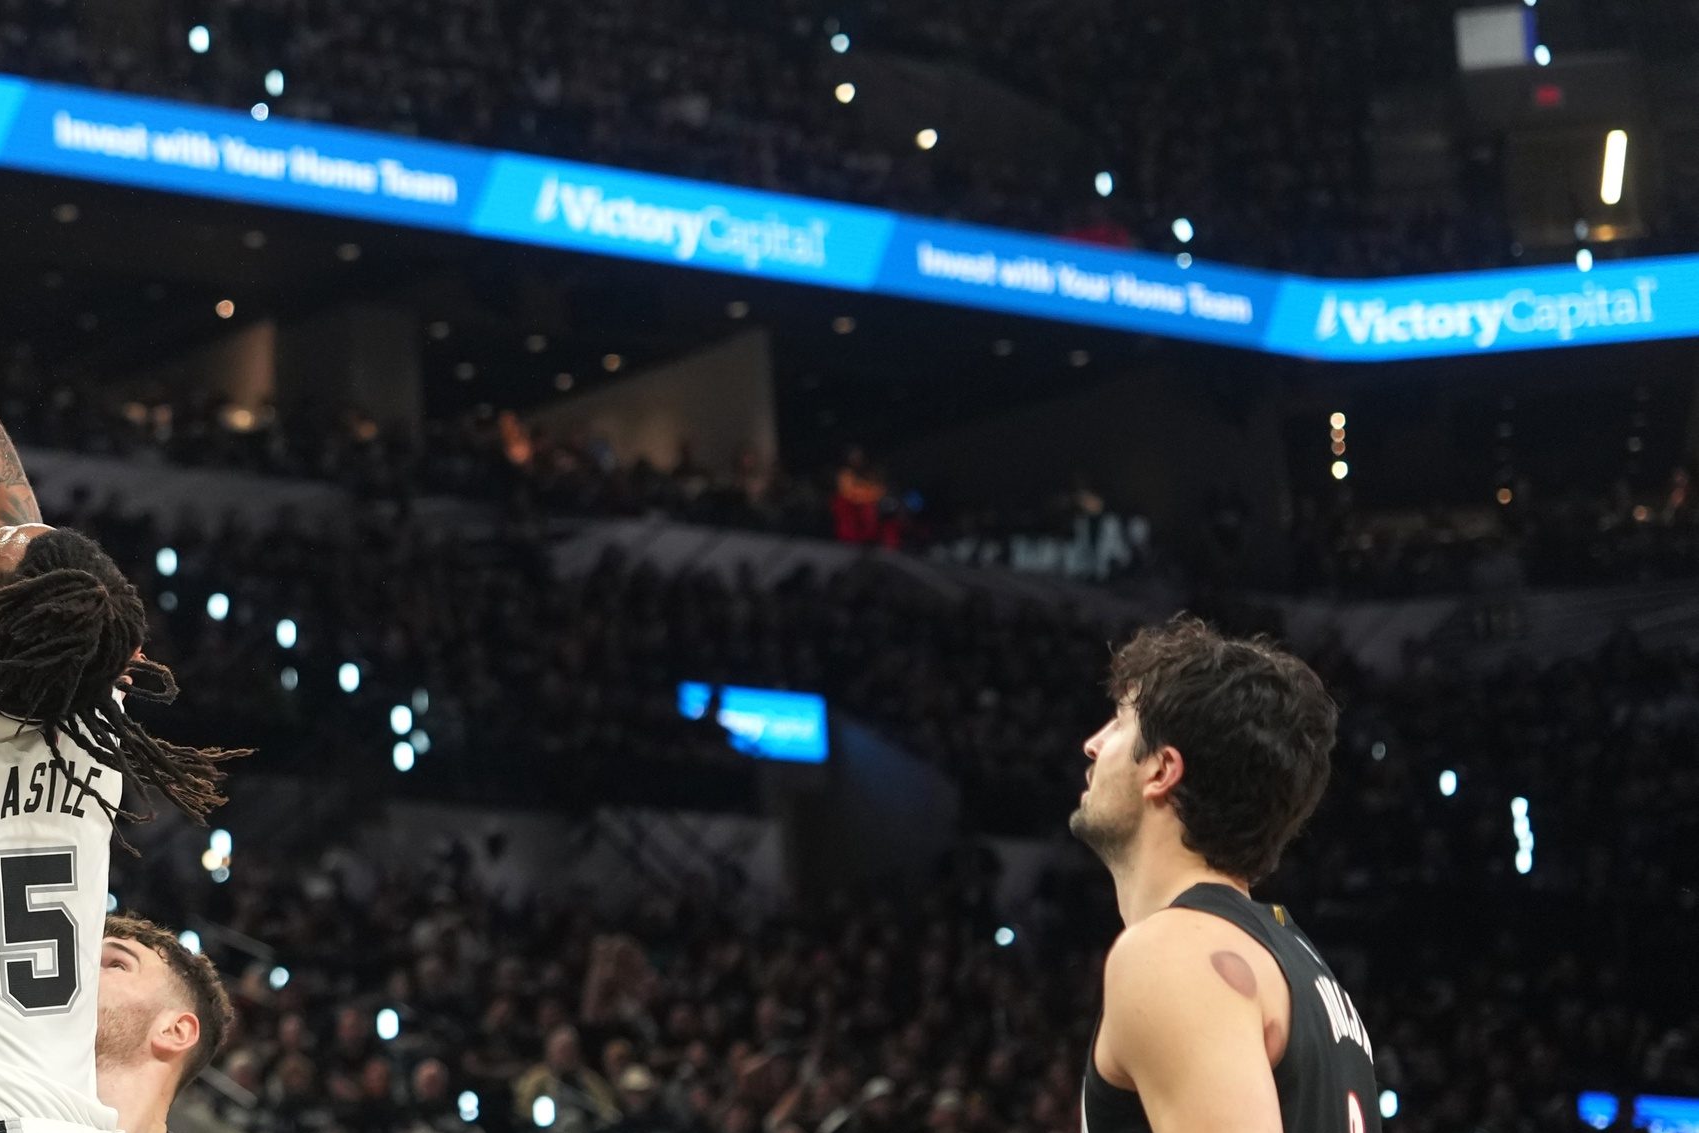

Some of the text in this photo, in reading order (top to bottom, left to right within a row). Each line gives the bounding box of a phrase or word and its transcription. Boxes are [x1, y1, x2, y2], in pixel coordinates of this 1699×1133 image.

[53, 110, 459, 206] Invest with Your Home Team
[999, 255, 1056, 294] with
[1056, 260, 1111, 304] Your
[1112, 270, 1187, 315] Home
[1188, 281, 1253, 325] Team
